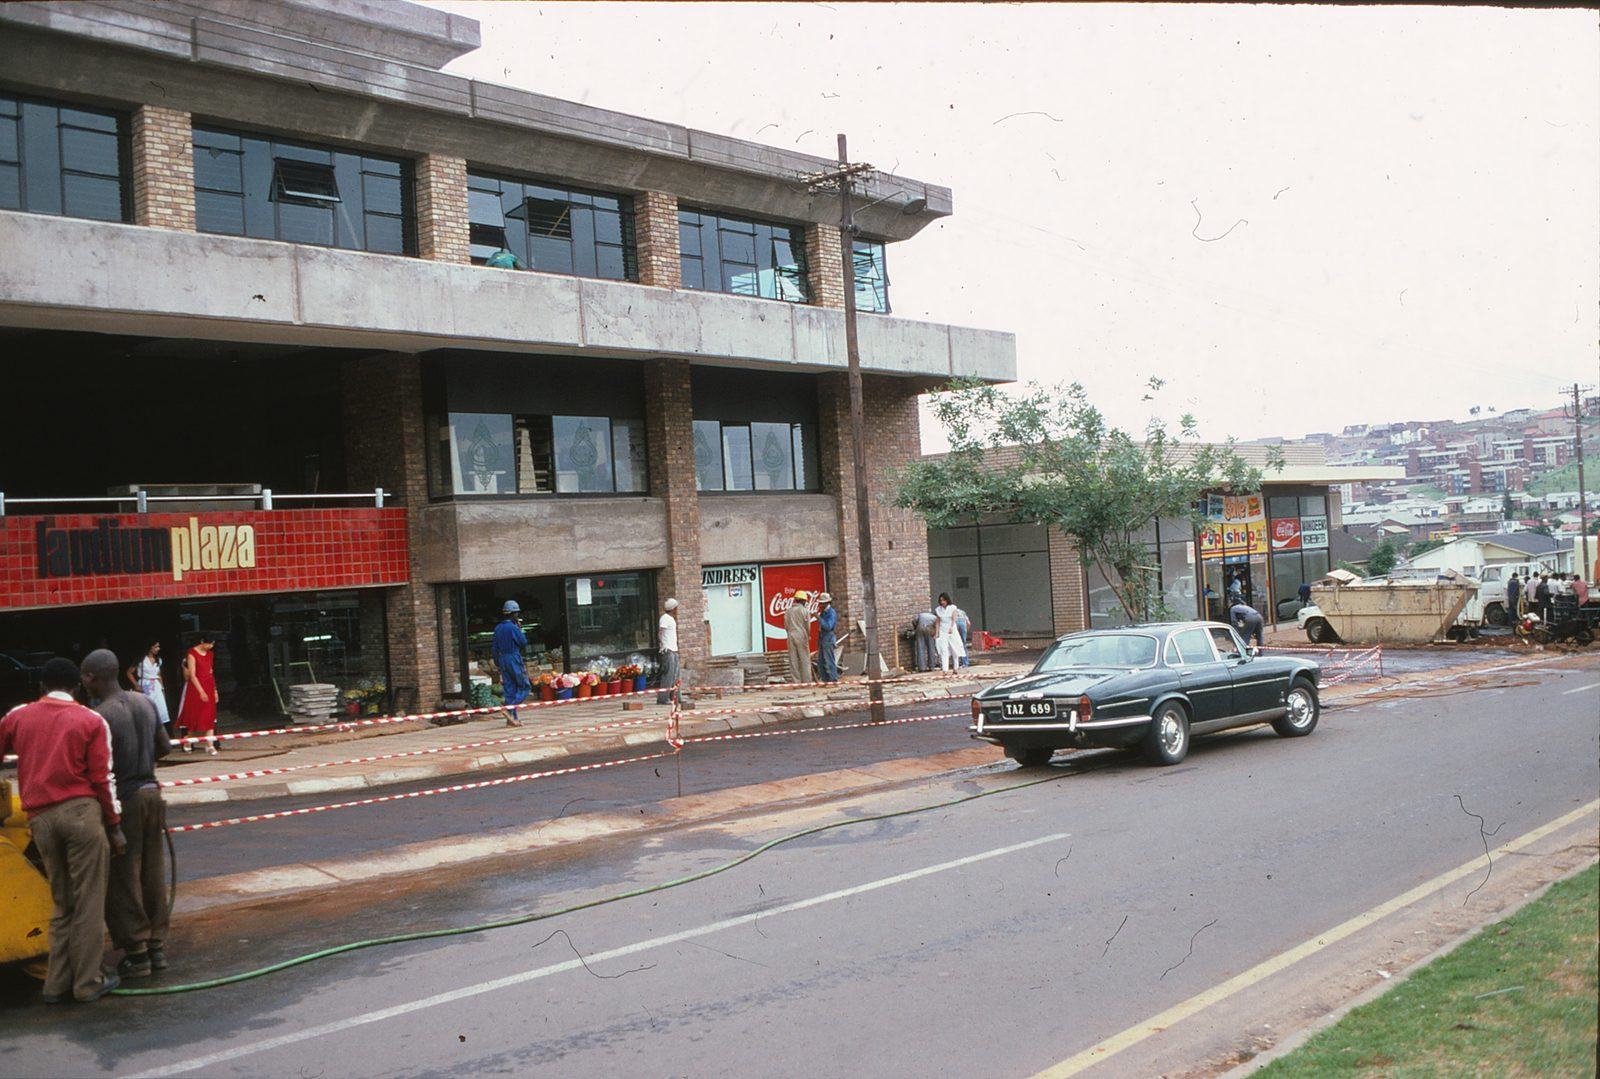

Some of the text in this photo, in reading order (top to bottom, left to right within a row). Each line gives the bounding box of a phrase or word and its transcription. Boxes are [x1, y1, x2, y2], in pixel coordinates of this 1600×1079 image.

[36, 516, 256, 581] laudium plaza
[1006, 703, 1051, 715] TAZ 689
